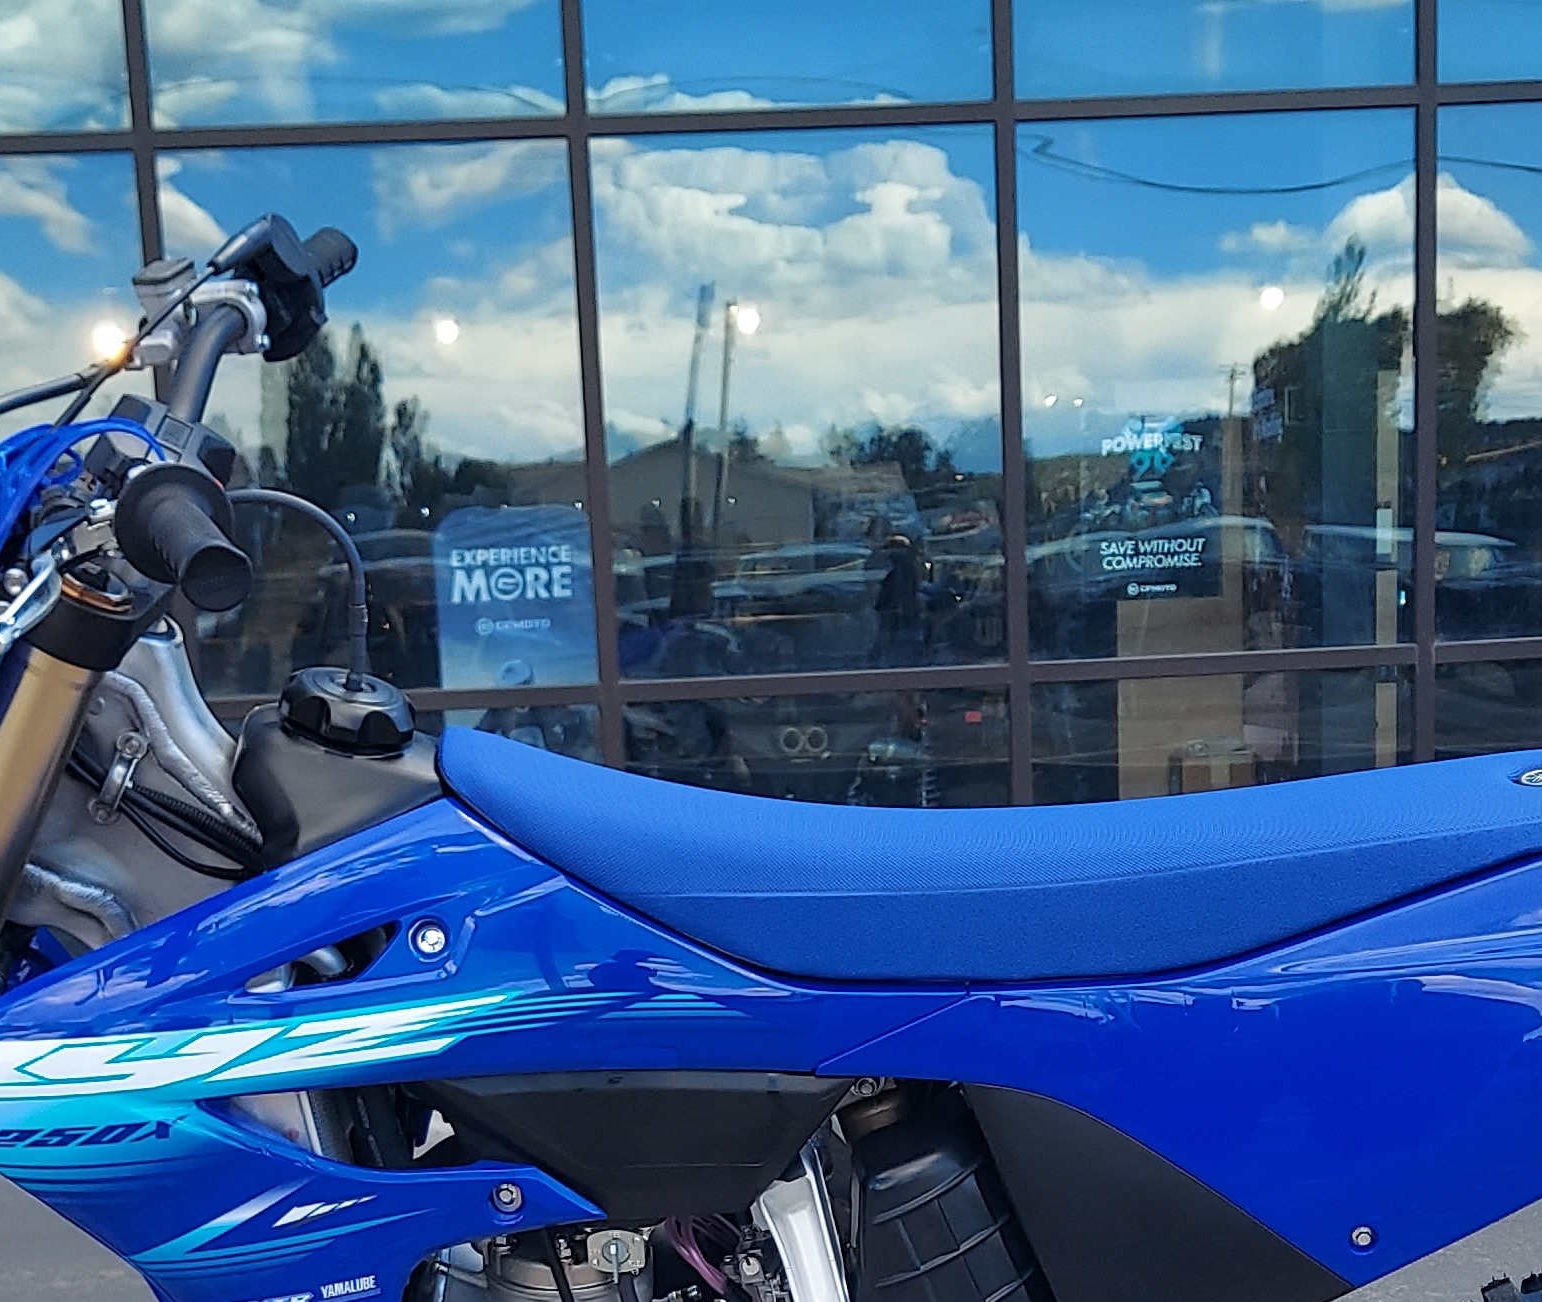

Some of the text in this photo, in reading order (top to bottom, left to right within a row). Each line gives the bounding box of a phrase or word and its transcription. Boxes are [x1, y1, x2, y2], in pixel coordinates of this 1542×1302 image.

[450, 544, 572, 567] EXPERIENCE
[1100, 538, 1206, 555] SAVE WITHOUT
[1102, 553, 1203, 570] COMPROMISE.
[451, 564, 573, 604] MORE
[320, 1275, 376, 1299] YAMALUBE
